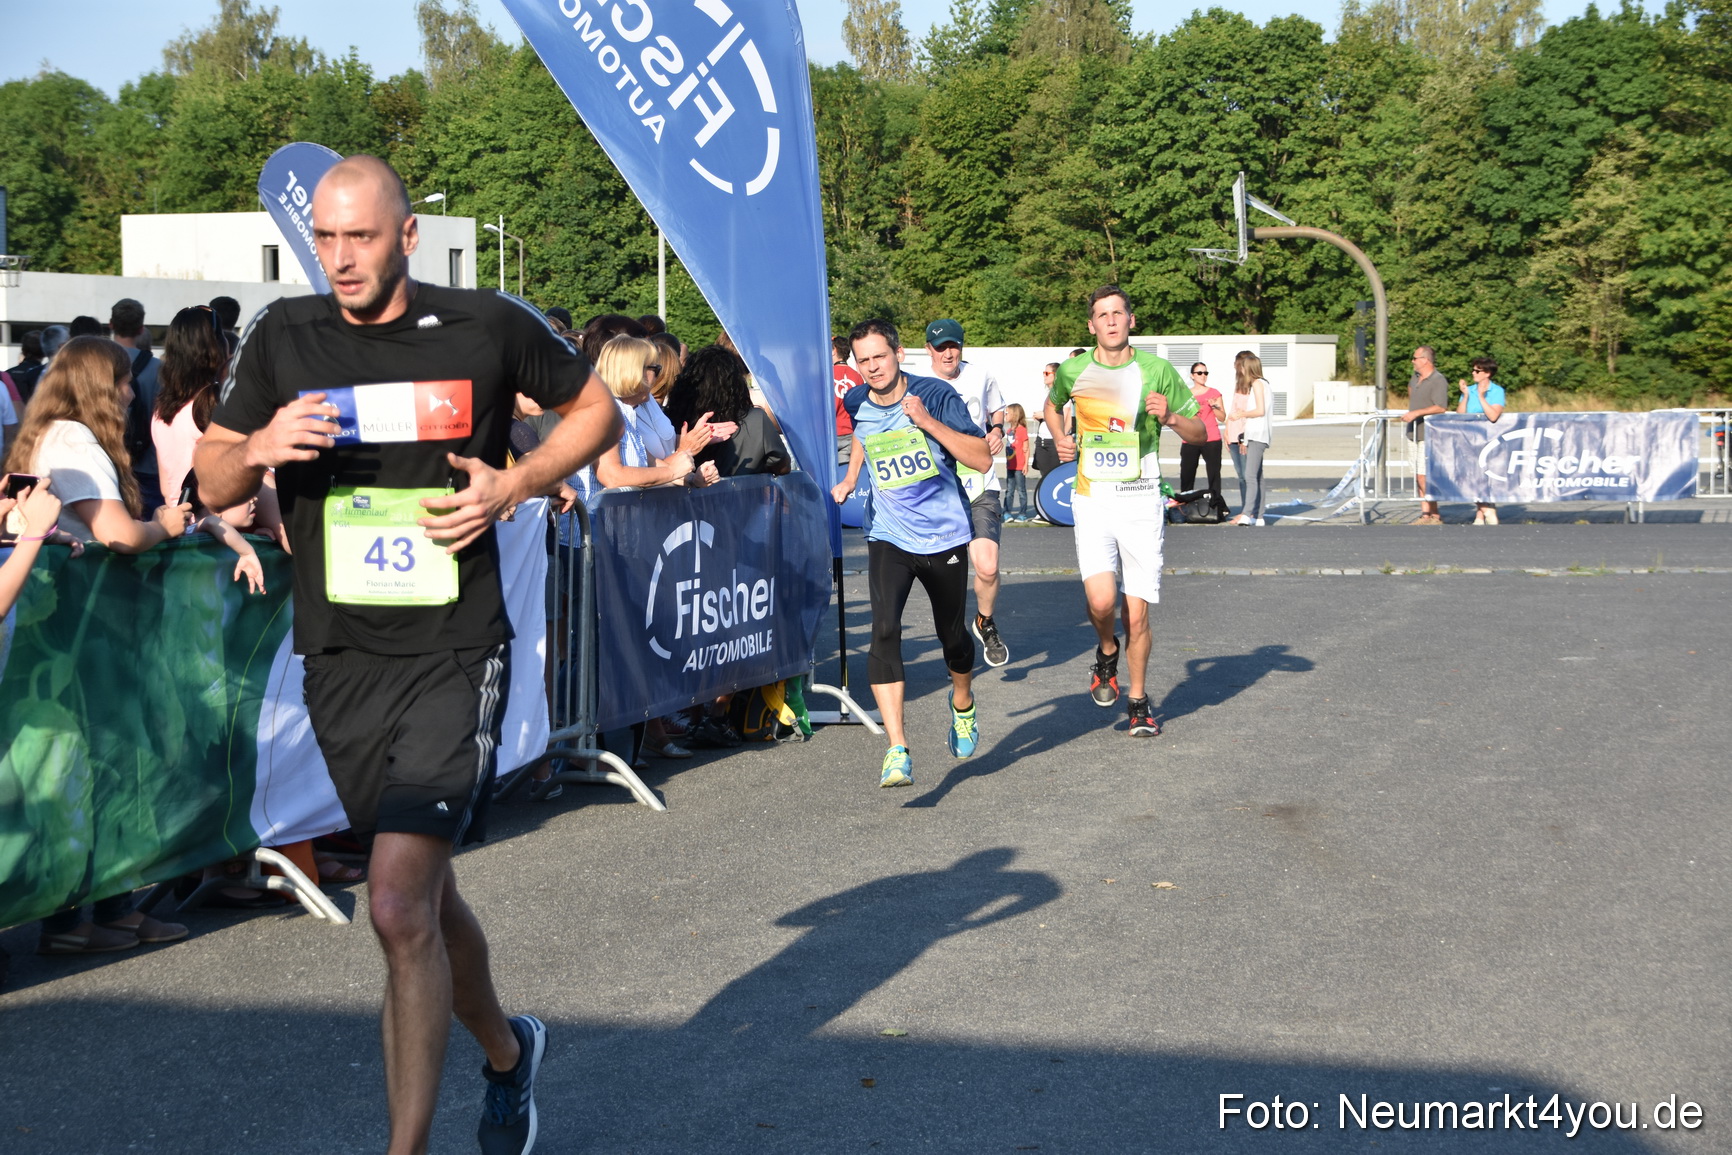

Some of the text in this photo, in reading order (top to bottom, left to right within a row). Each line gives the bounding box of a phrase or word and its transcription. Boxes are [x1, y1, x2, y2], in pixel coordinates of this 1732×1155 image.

[876, 450, 932, 481] 5196
[1094, 451, 1128, 467] 999
[1507, 449, 1641, 475] Fischer
[1518, 476, 1629, 488] AUTOMOBILE
[364, 536, 415, 572] 43
[682, 628, 773, 673] AUTOMOBILE
